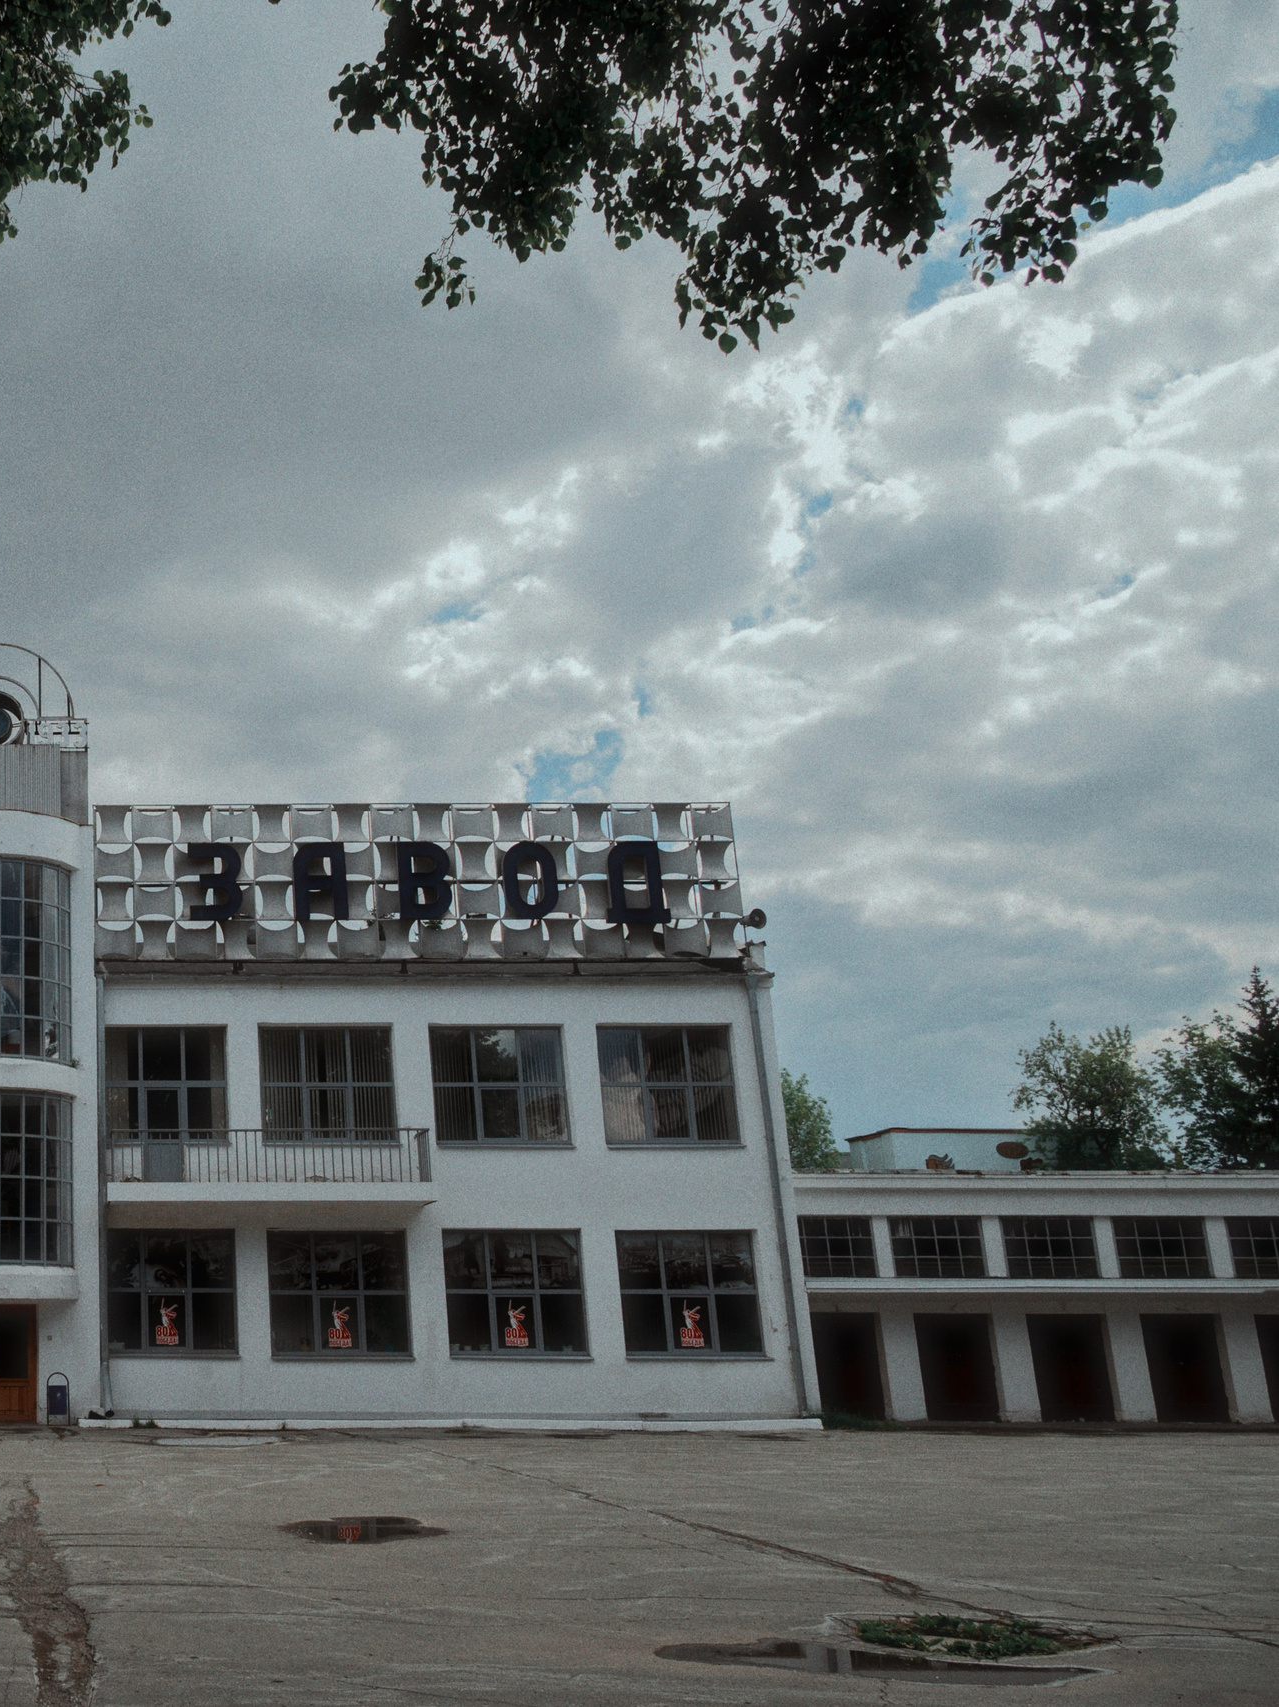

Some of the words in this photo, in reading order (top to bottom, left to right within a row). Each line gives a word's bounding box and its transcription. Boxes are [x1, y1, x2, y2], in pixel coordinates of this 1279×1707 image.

[29, 721, 88, 748] 1933
[187, 841, 672, 924] ЗАВОД
[156, 1326, 168, 1336] 80
[329, 1329, 340, 1339] 80
[506, 1328, 517, 1338] 80
[681, 1328, 692, 1338] 80
